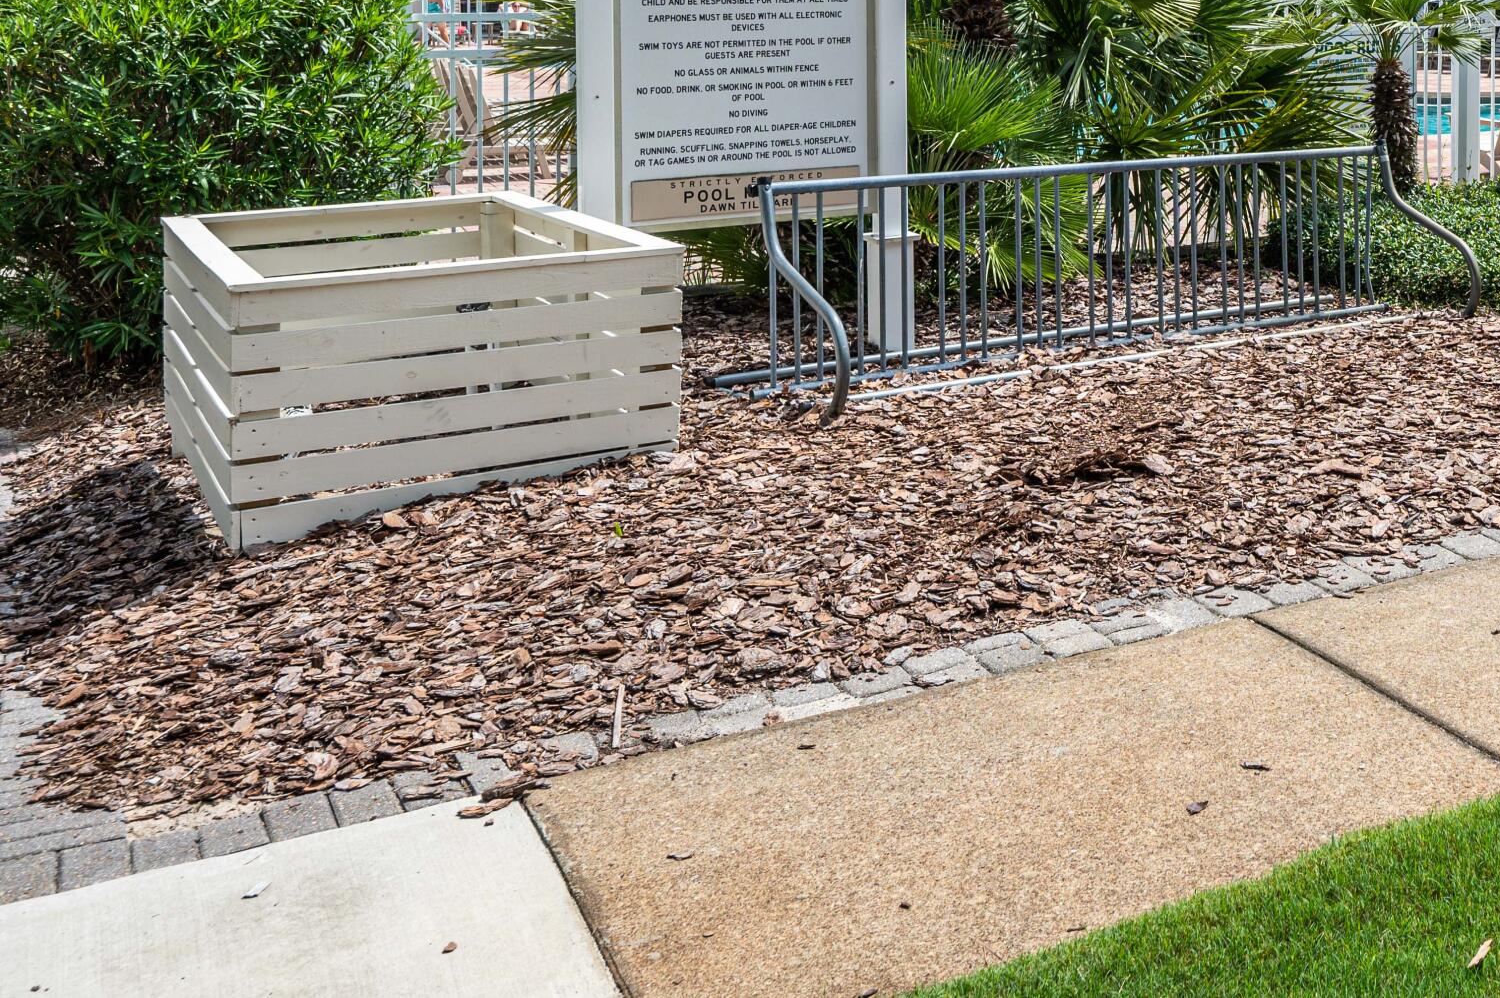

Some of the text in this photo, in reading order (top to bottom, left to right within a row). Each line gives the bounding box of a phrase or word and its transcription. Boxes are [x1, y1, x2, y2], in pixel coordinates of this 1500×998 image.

[648, 14, 697, 23] EARPHONES
[723, 13, 733, 21] BE
[735, 13, 756, 21] USED
[779, 12, 794, 20] ALL
[796, 11, 842, 19] ELECTRONIC
[731, 24, 765, 32] DEVICES
[639, 43, 660, 51] SWIM
[662, 42, 684, 50] TOYS
[704, 41, 721, 49] NOT
[722, 40, 767, 48] PERMITTED
[795, 38, 816, 46] POOL
[827, 37, 851, 45] OTHER
[705, 50, 791, 60] GUESTS ARE PRESENT
[688, 69, 715, 77] GLASS
[717, 68, 728, 76] OR
[730, 67, 765, 75] ANIMALS
[795, 64, 819, 72] FENCE
[718, 83, 753, 91] SMOKING
[800, 80, 827, 88] WITHIN
[732, 94, 742, 102] OF
[742, 109, 769, 117] DIVING
[635, 120, 857, 140] SWIM DIAPERS REQUIRED FOR ALL DIAPER-AGE CHILDREN
[729, 141, 768, 150] SNAPPING
[635, 160, 646, 168] OR
[648, 158, 665, 166] TAG
[667, 157, 695, 165] GAMES
[721, 153, 753, 161] AROUND
[772, 150, 793, 158] POOL
[795, 149, 803, 157] IS
[804, 148, 819, 156] NOT
[821, 146, 857, 155] ALLOWED
[670, 172, 823, 189] STRICTLY EFORCED
[683, 188, 735, 203] POOL
[700, 202, 735, 213] DAWN
